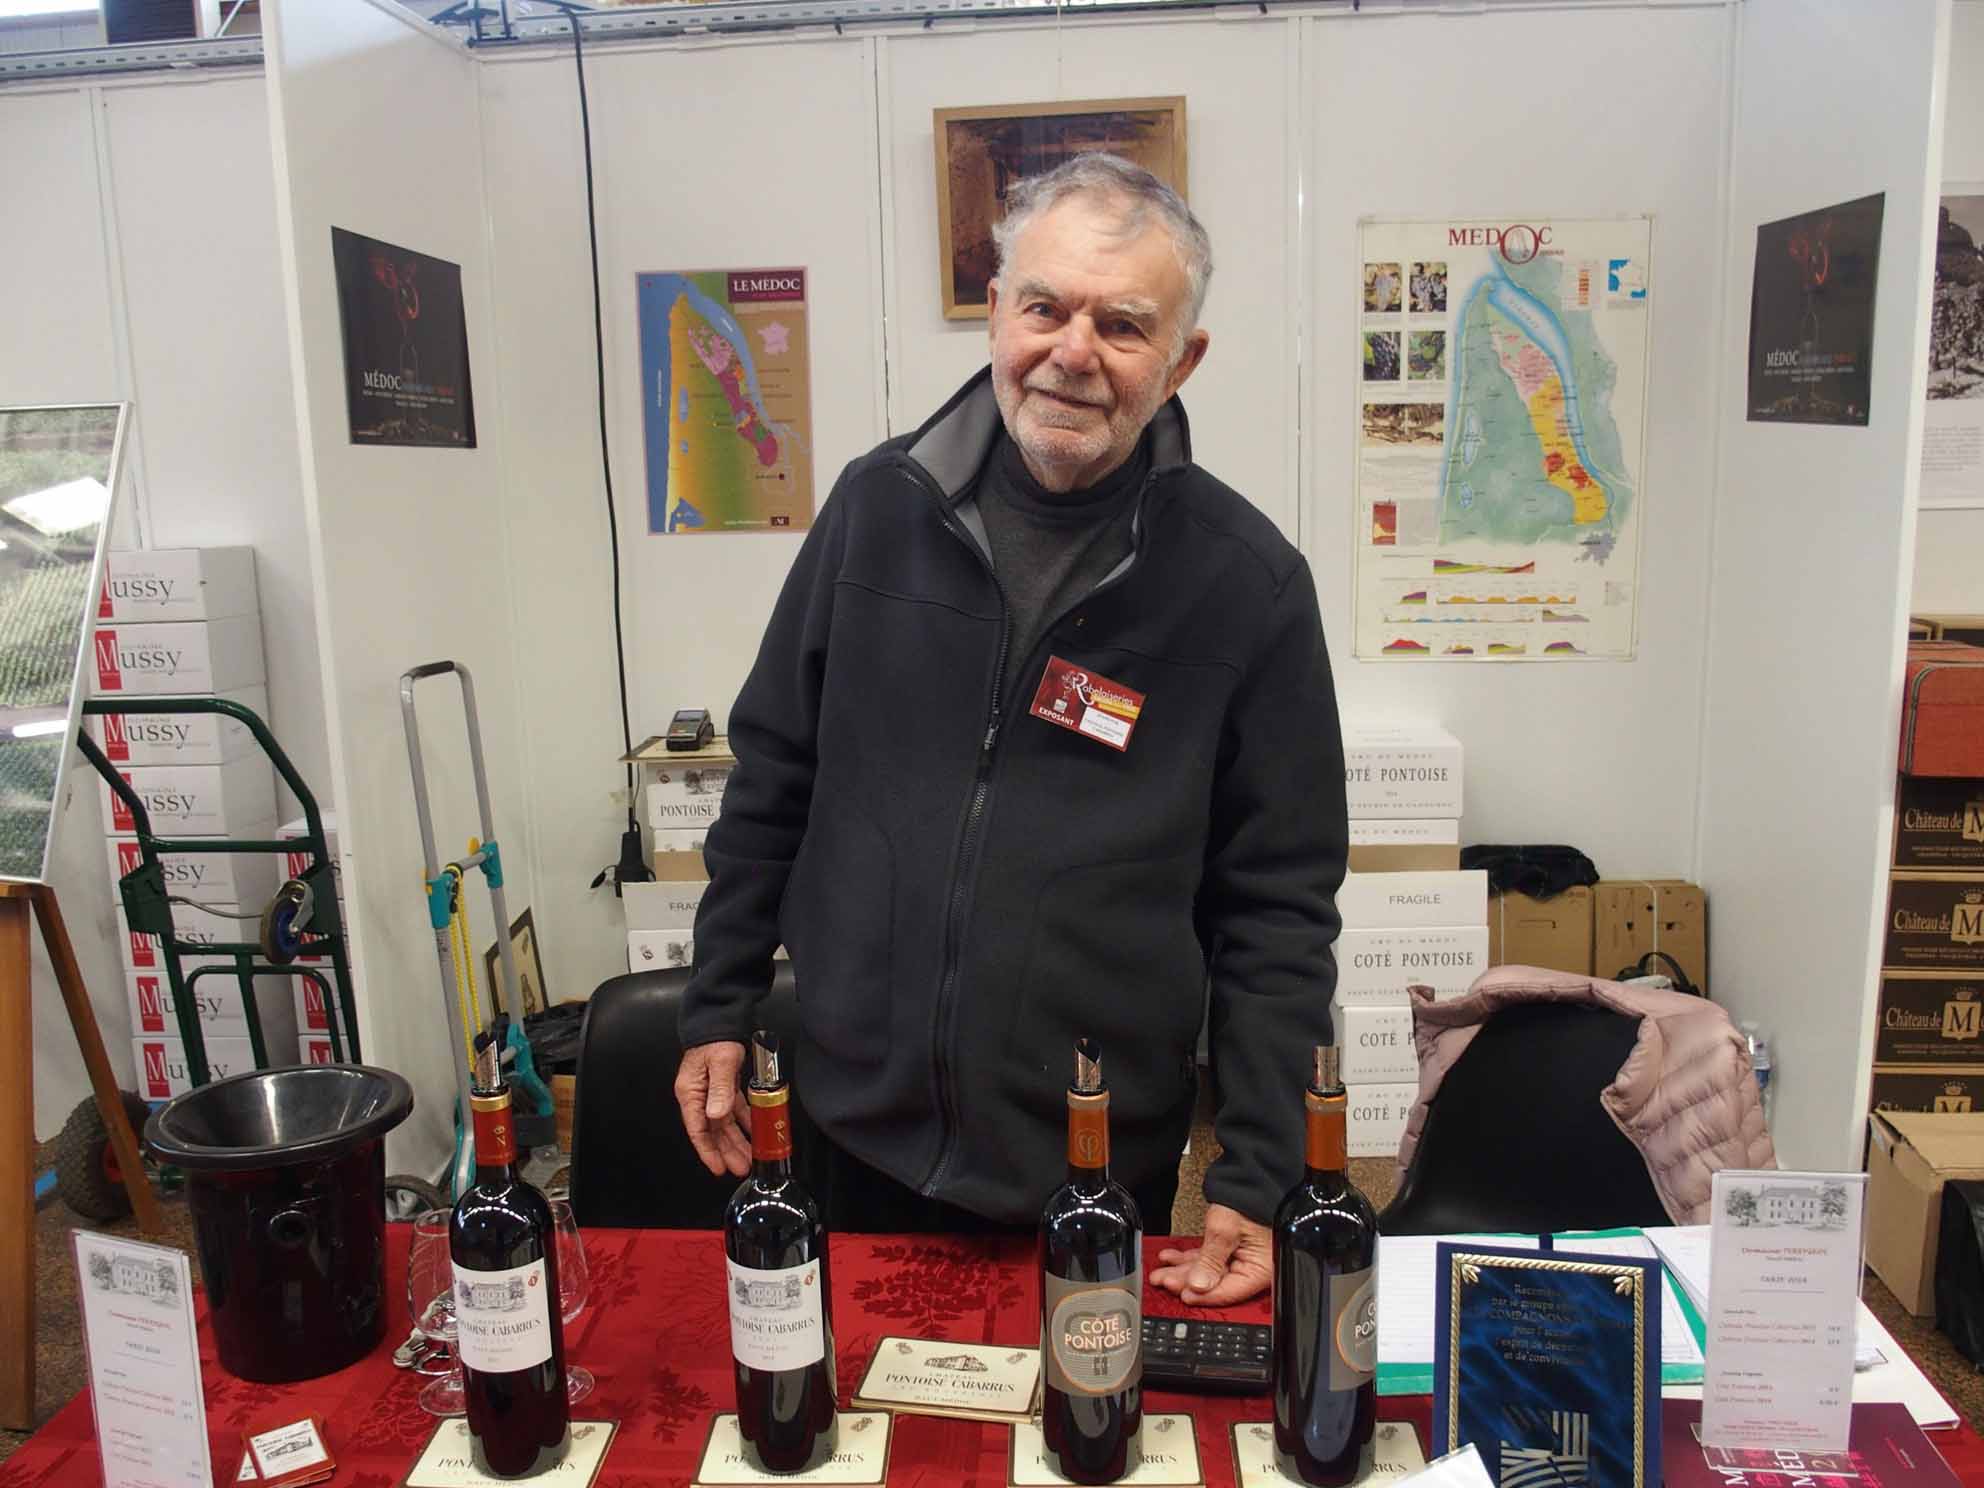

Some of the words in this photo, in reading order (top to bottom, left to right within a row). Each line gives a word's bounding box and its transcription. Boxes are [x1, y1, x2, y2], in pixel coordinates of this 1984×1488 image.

[733, 279, 750, 293] LE
[1766, 349, 1798, 368] MÉDOC
[363, 368, 401, 390] MÉDOC
[98, 639, 182, 676] Mussy
[1039, 707, 1074, 726] EXPOSANT
[105, 713, 190, 749] Mussy
[1345, 763, 1371, 782] OTÉ
[1380, 767, 1448, 782] PONTOISE
[660, 803, 715, 818] PONTOISE
[1905, 808, 1950, 829] Château
[1950, 811, 1963, 829] de
[120, 850, 205, 888] Mssy
[669, 902, 700, 912] FRAG
[1388, 894, 1441, 905] FRAGILE
[1894, 909, 1938, 930] Château
[1938, 912, 1951, 930] de
[1958, 910, 1983, 936] M
[1401, 951, 1474, 967] PONTOISE
[140, 985, 223, 1021] Musy
[1886, 1008, 1930, 1028] Château
[1929, 1010, 1942, 1028] de
[1949, 1006, 1974, 1032] M
[1064, 1328, 1132, 1350] PONTOISE
[886, 1373, 945, 1388] PONTOISE
[951, 1379, 1017, 1393] CABARRUS
[438, 1458, 474, 1468] PONT
[827, 1452, 865, 1464] RRUS
[1142, 1455, 1177, 1465] RRUS
